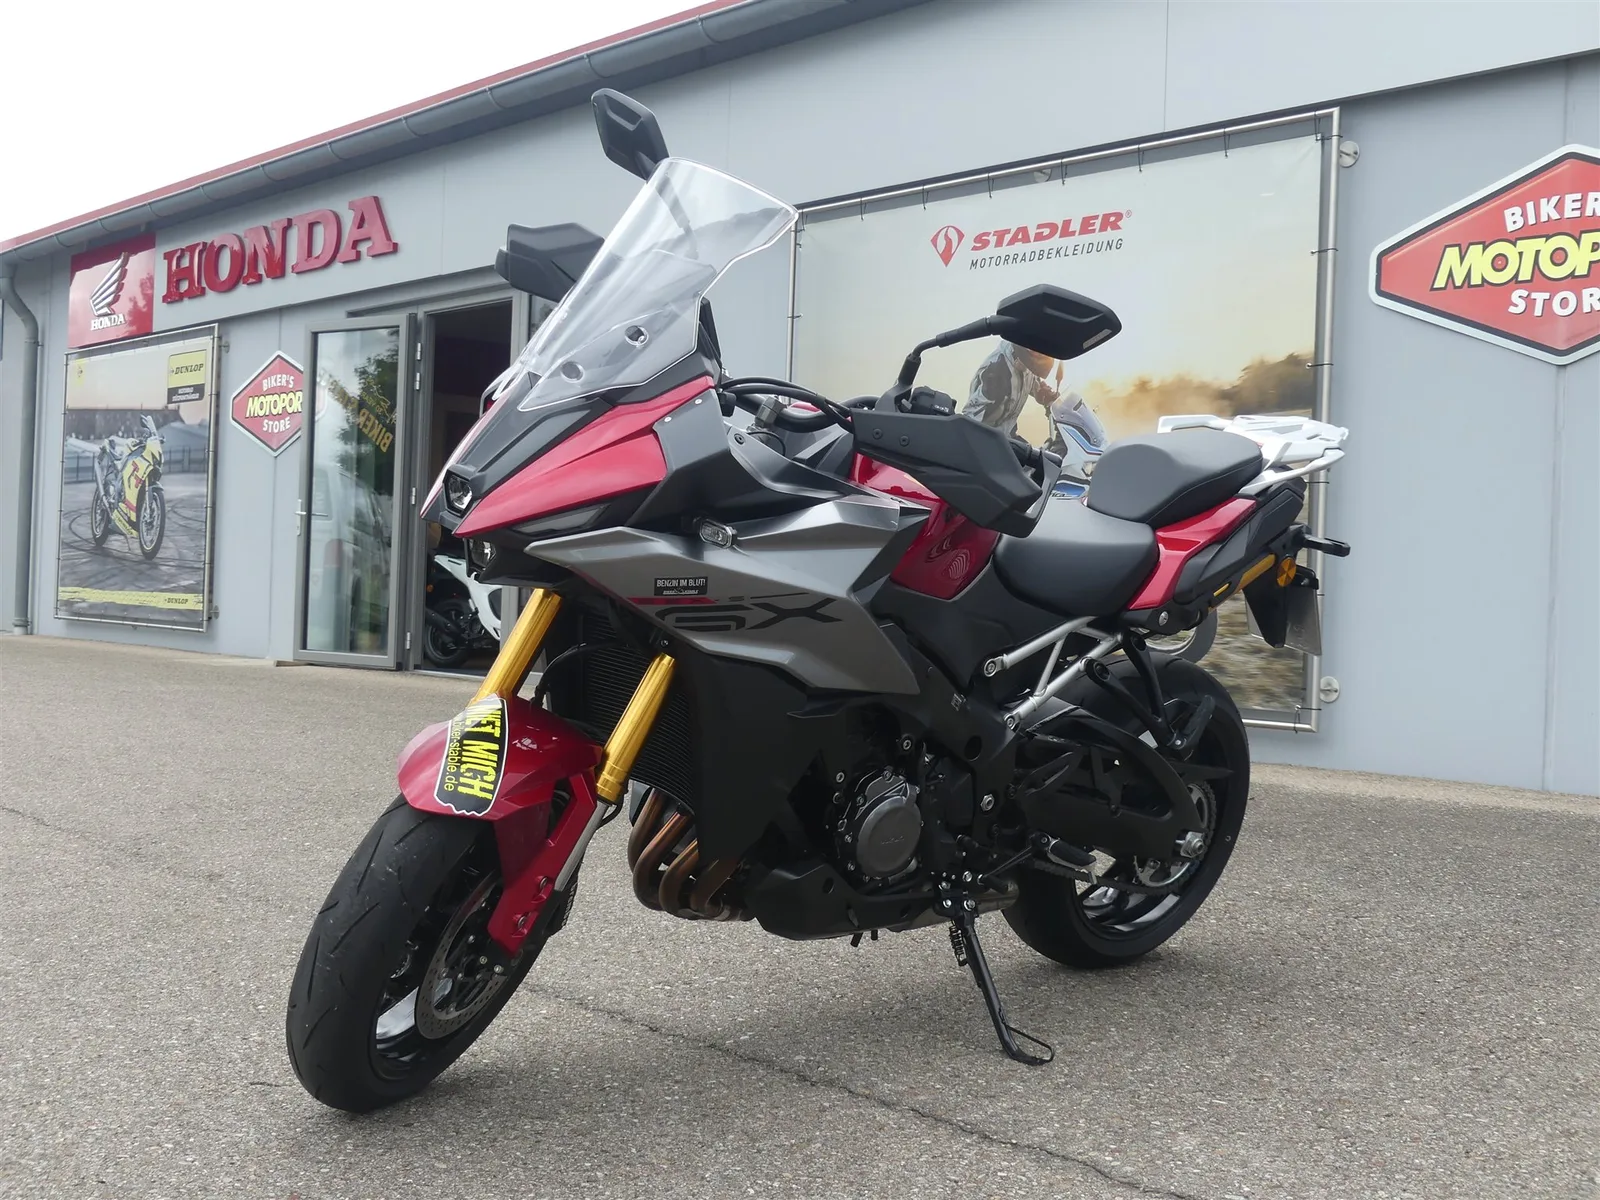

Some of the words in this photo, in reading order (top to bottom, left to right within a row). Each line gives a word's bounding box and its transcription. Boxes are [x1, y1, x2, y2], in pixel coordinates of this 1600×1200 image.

[1503, 191, 1600, 233] BIKER
[970, 211, 1124, 251] STADLER
[162, 195, 399, 304] HONDA
[969, 238, 1124, 270] MOTORRADBEKLEIDUNG
[1430, 229, 1600, 291] MOTOP
[1507, 286, 1600, 318] STOR
[90, 313, 126, 331] HONDA
[174, 363, 204, 375] DUNLOP
[262, 374, 294, 392] BIKER'S
[245, 390, 303, 418] MOTOPOR
[262, 416, 291, 433] STORE
[656, 579, 679, 587] BENZIN
[679, 578, 688, 587] IM
[688, 578, 706, 587] BLUT!
[167, 597, 189, 605] DUNLOP
[457, 739, 500, 800] MICH
